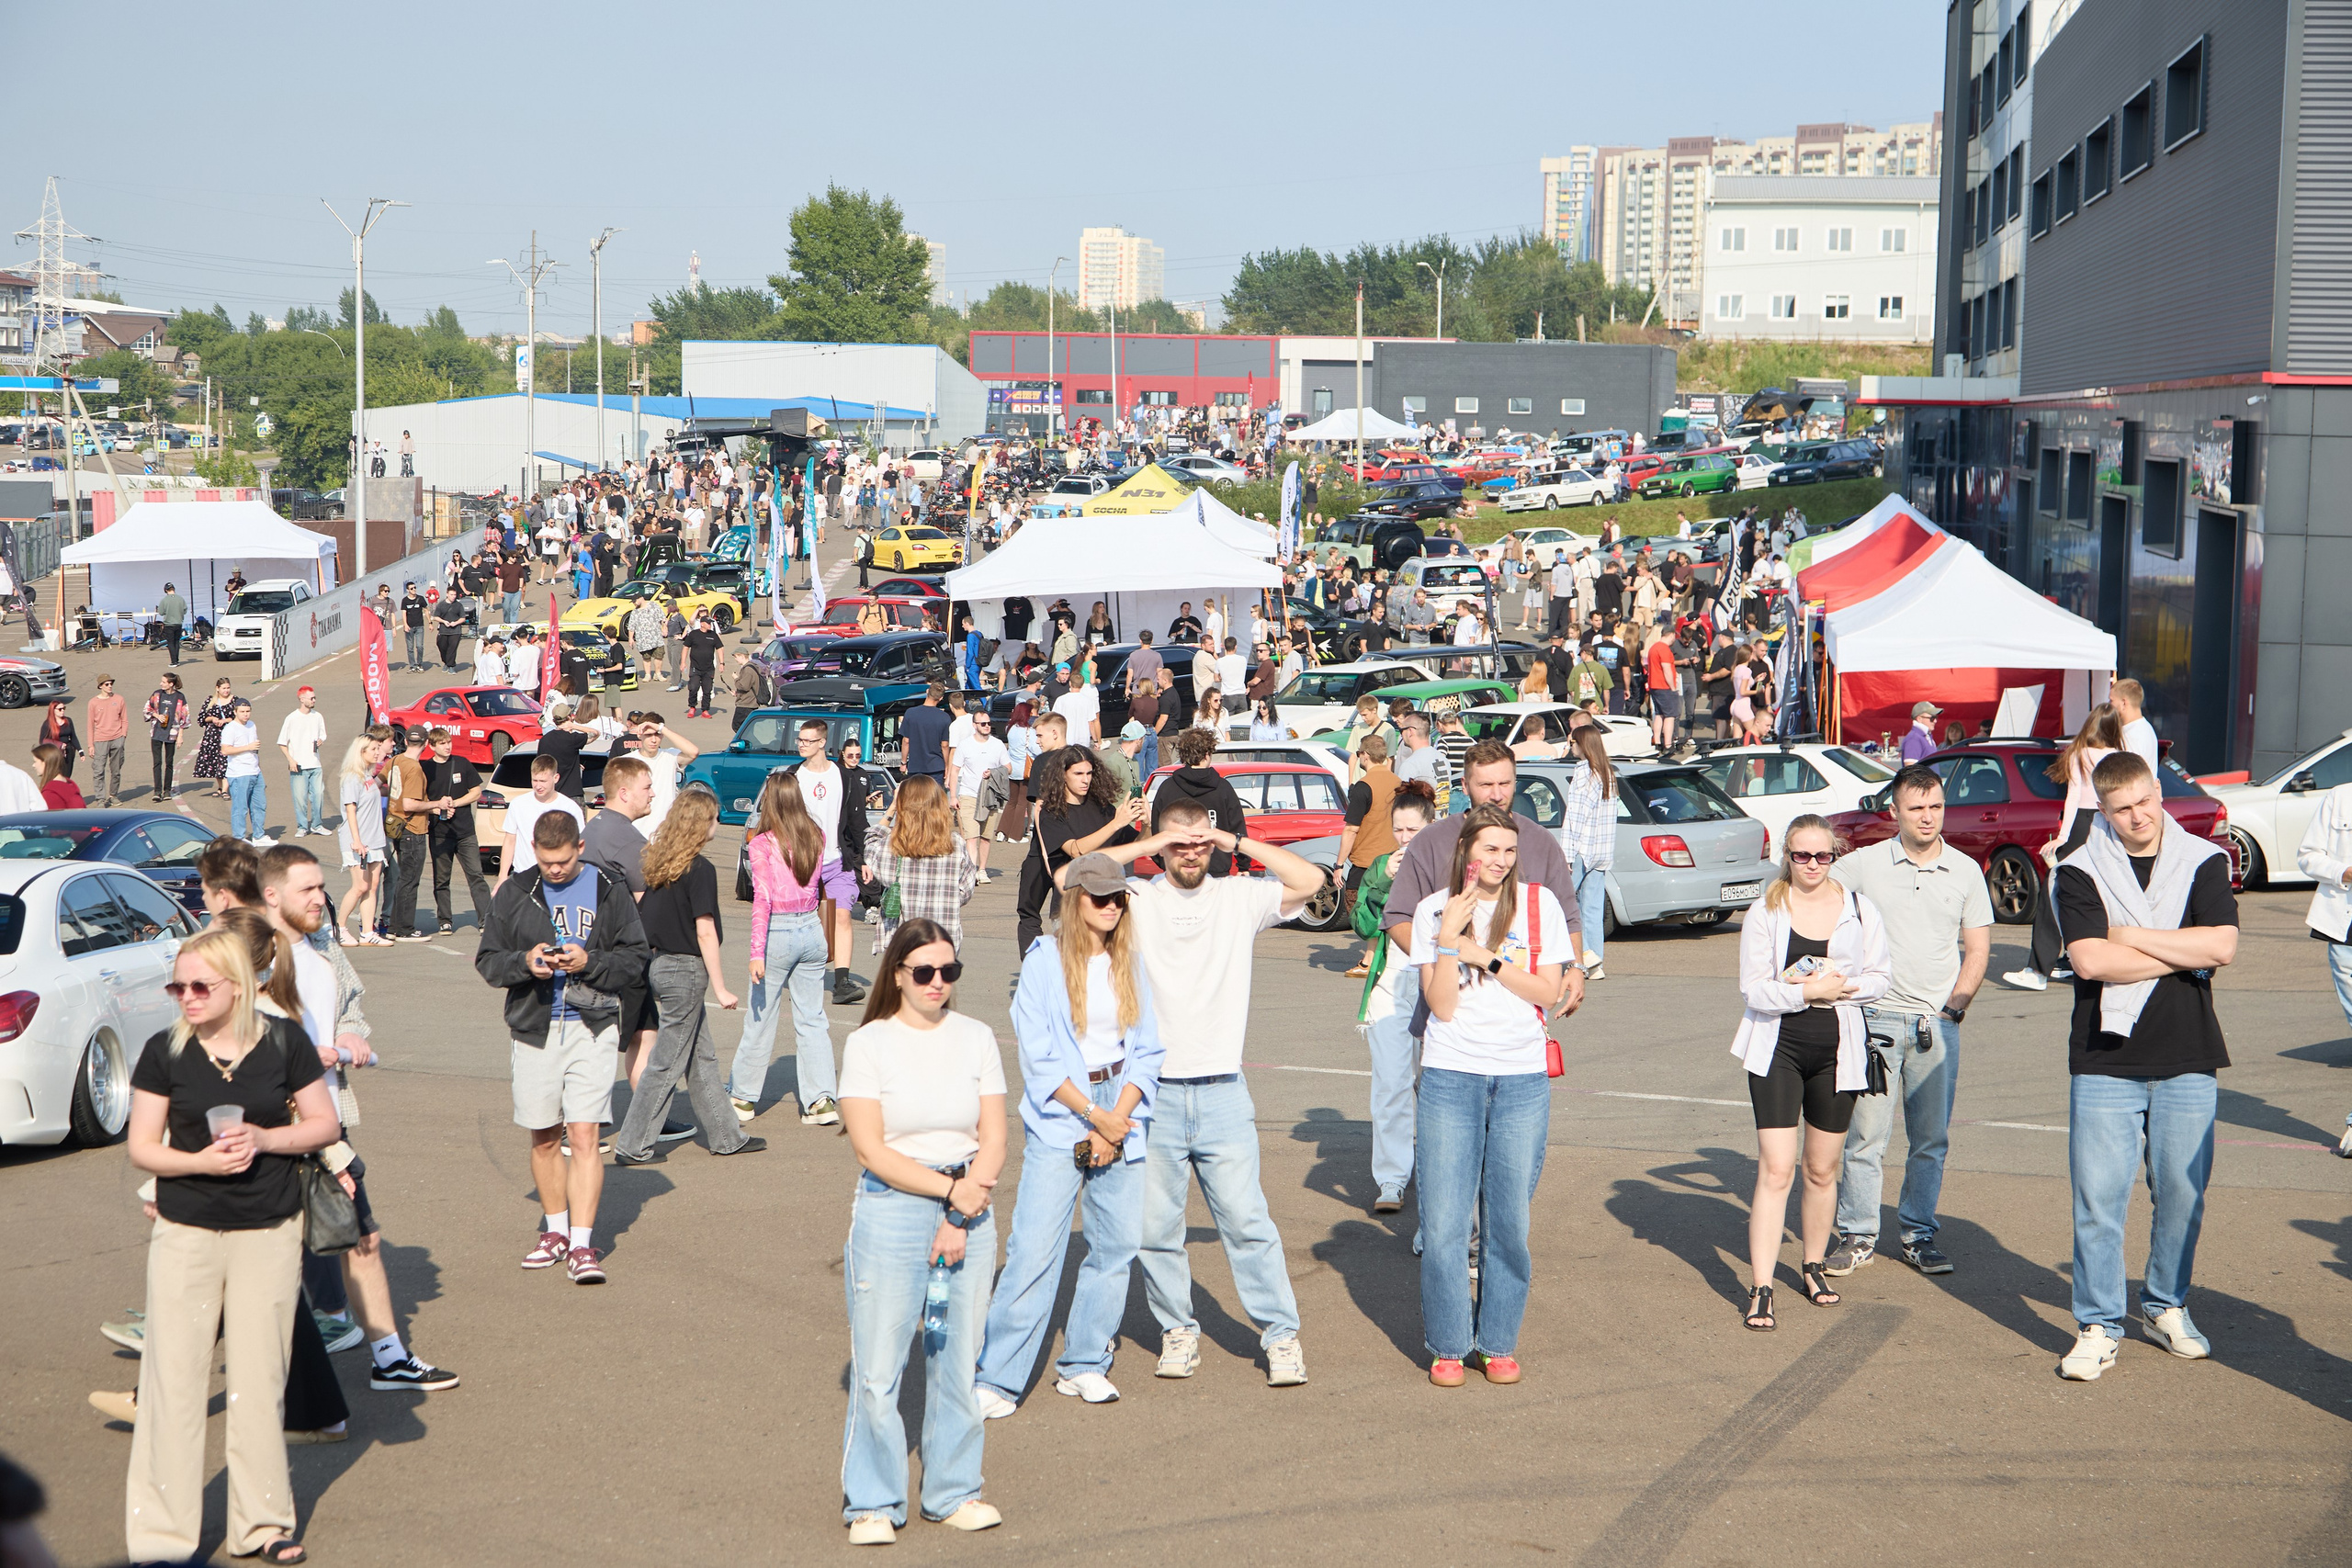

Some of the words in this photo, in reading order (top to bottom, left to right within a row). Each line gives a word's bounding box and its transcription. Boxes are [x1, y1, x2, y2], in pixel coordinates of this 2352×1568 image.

[1012, 404, 1062, 414] AODES
[1120, 489, 1167, 499] N31
[318, 611, 342, 639] TAKAYAMA
